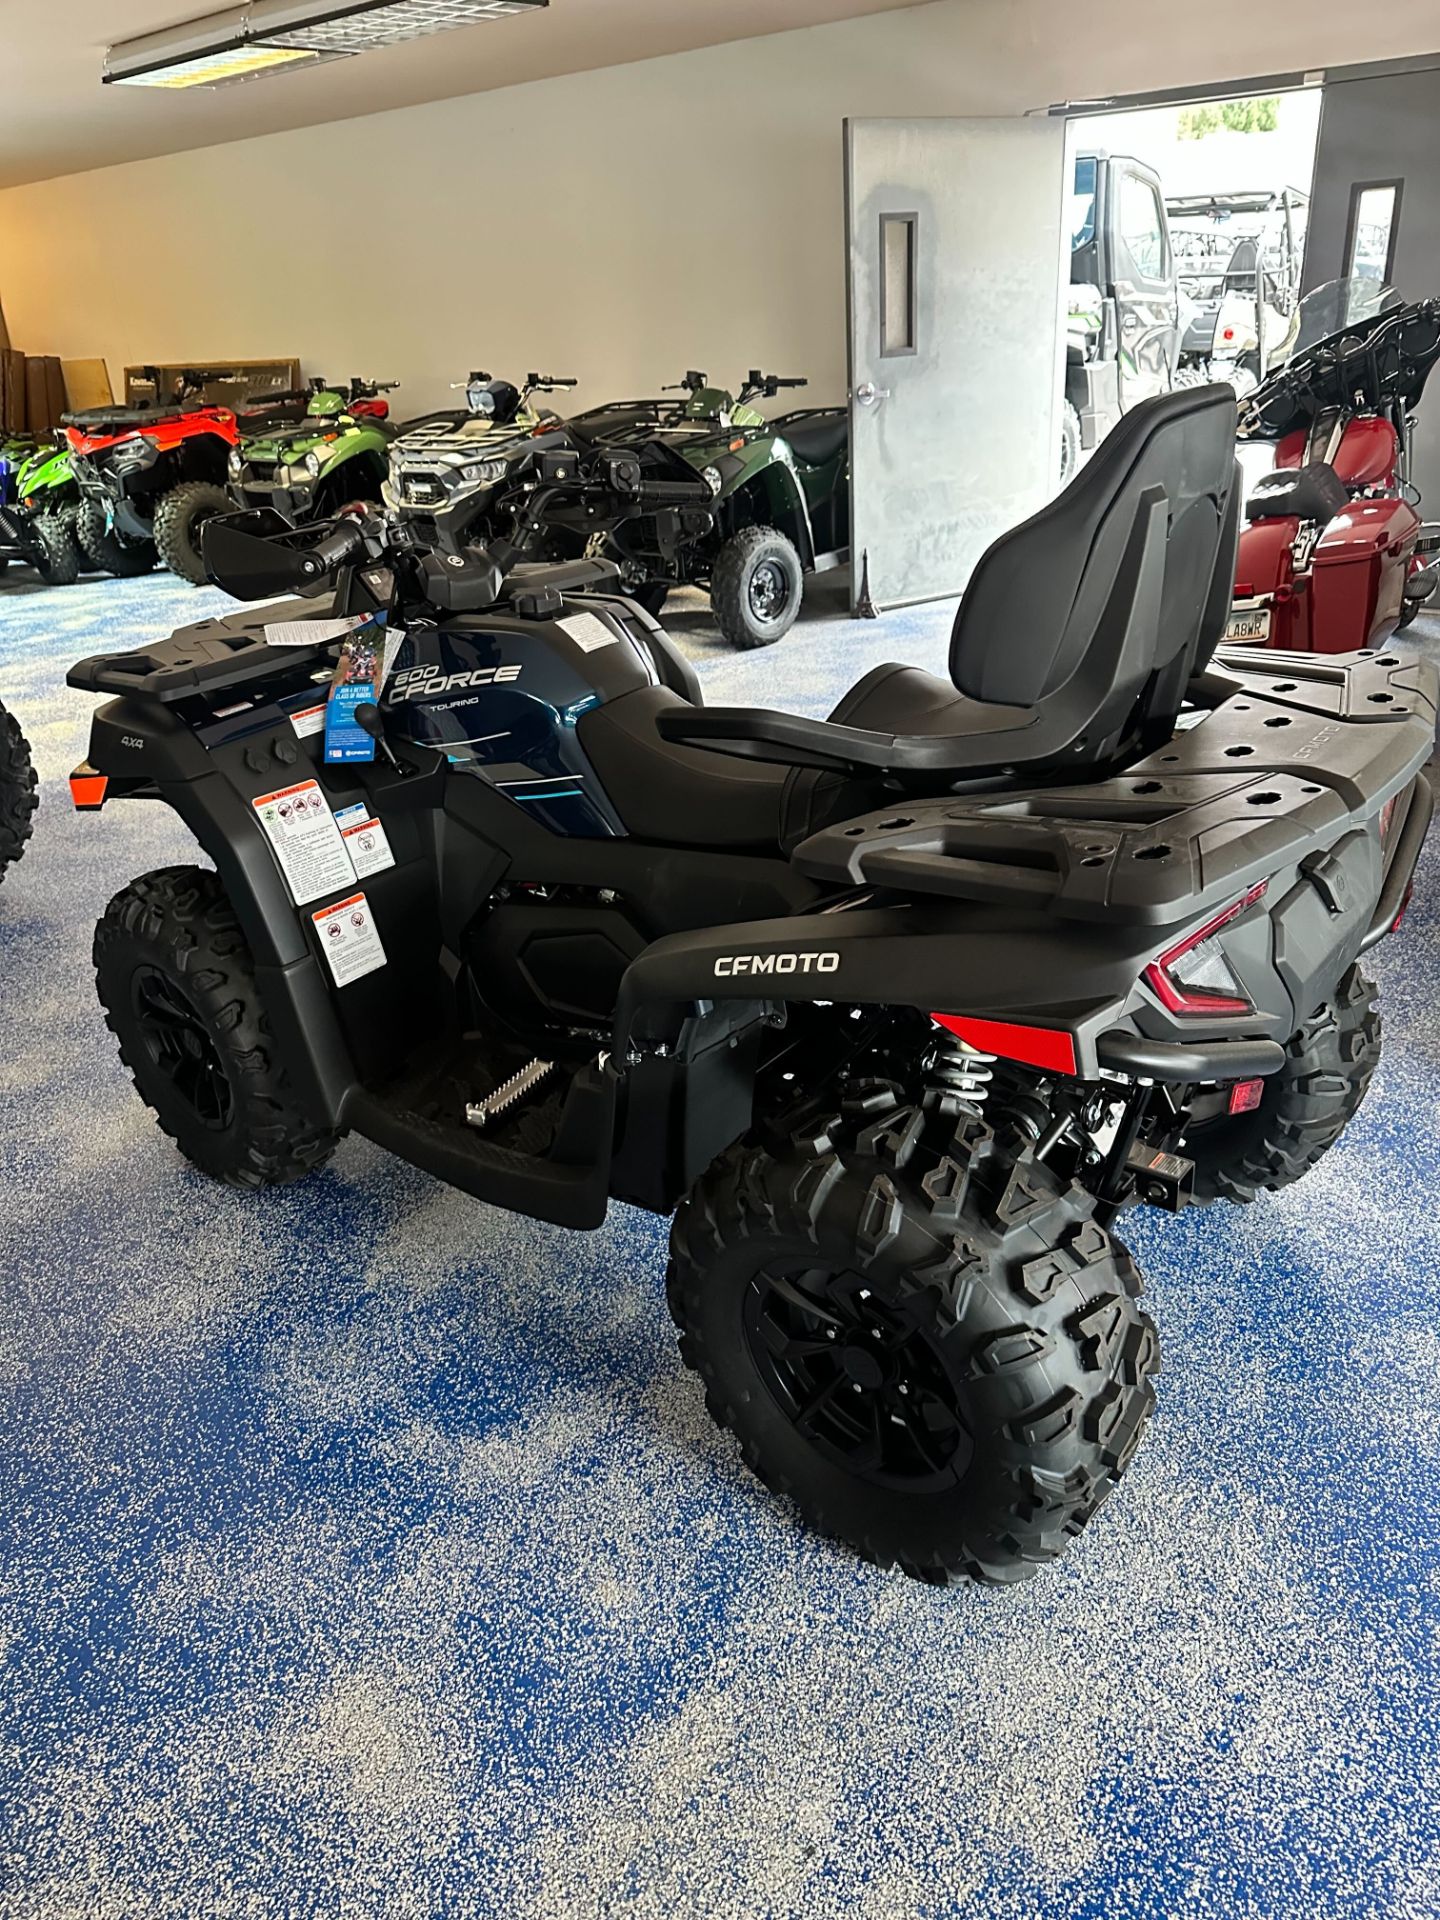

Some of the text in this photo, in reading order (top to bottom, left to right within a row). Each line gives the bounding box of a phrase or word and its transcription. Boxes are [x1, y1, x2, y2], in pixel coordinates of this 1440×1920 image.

[388, 665, 523, 705] CFORCE
[395, 665, 440, 686] 600
[430, 697, 480, 712] TOURING
[121, 735, 144, 750] 4X4
[713, 952, 840, 977] CFMOTO
